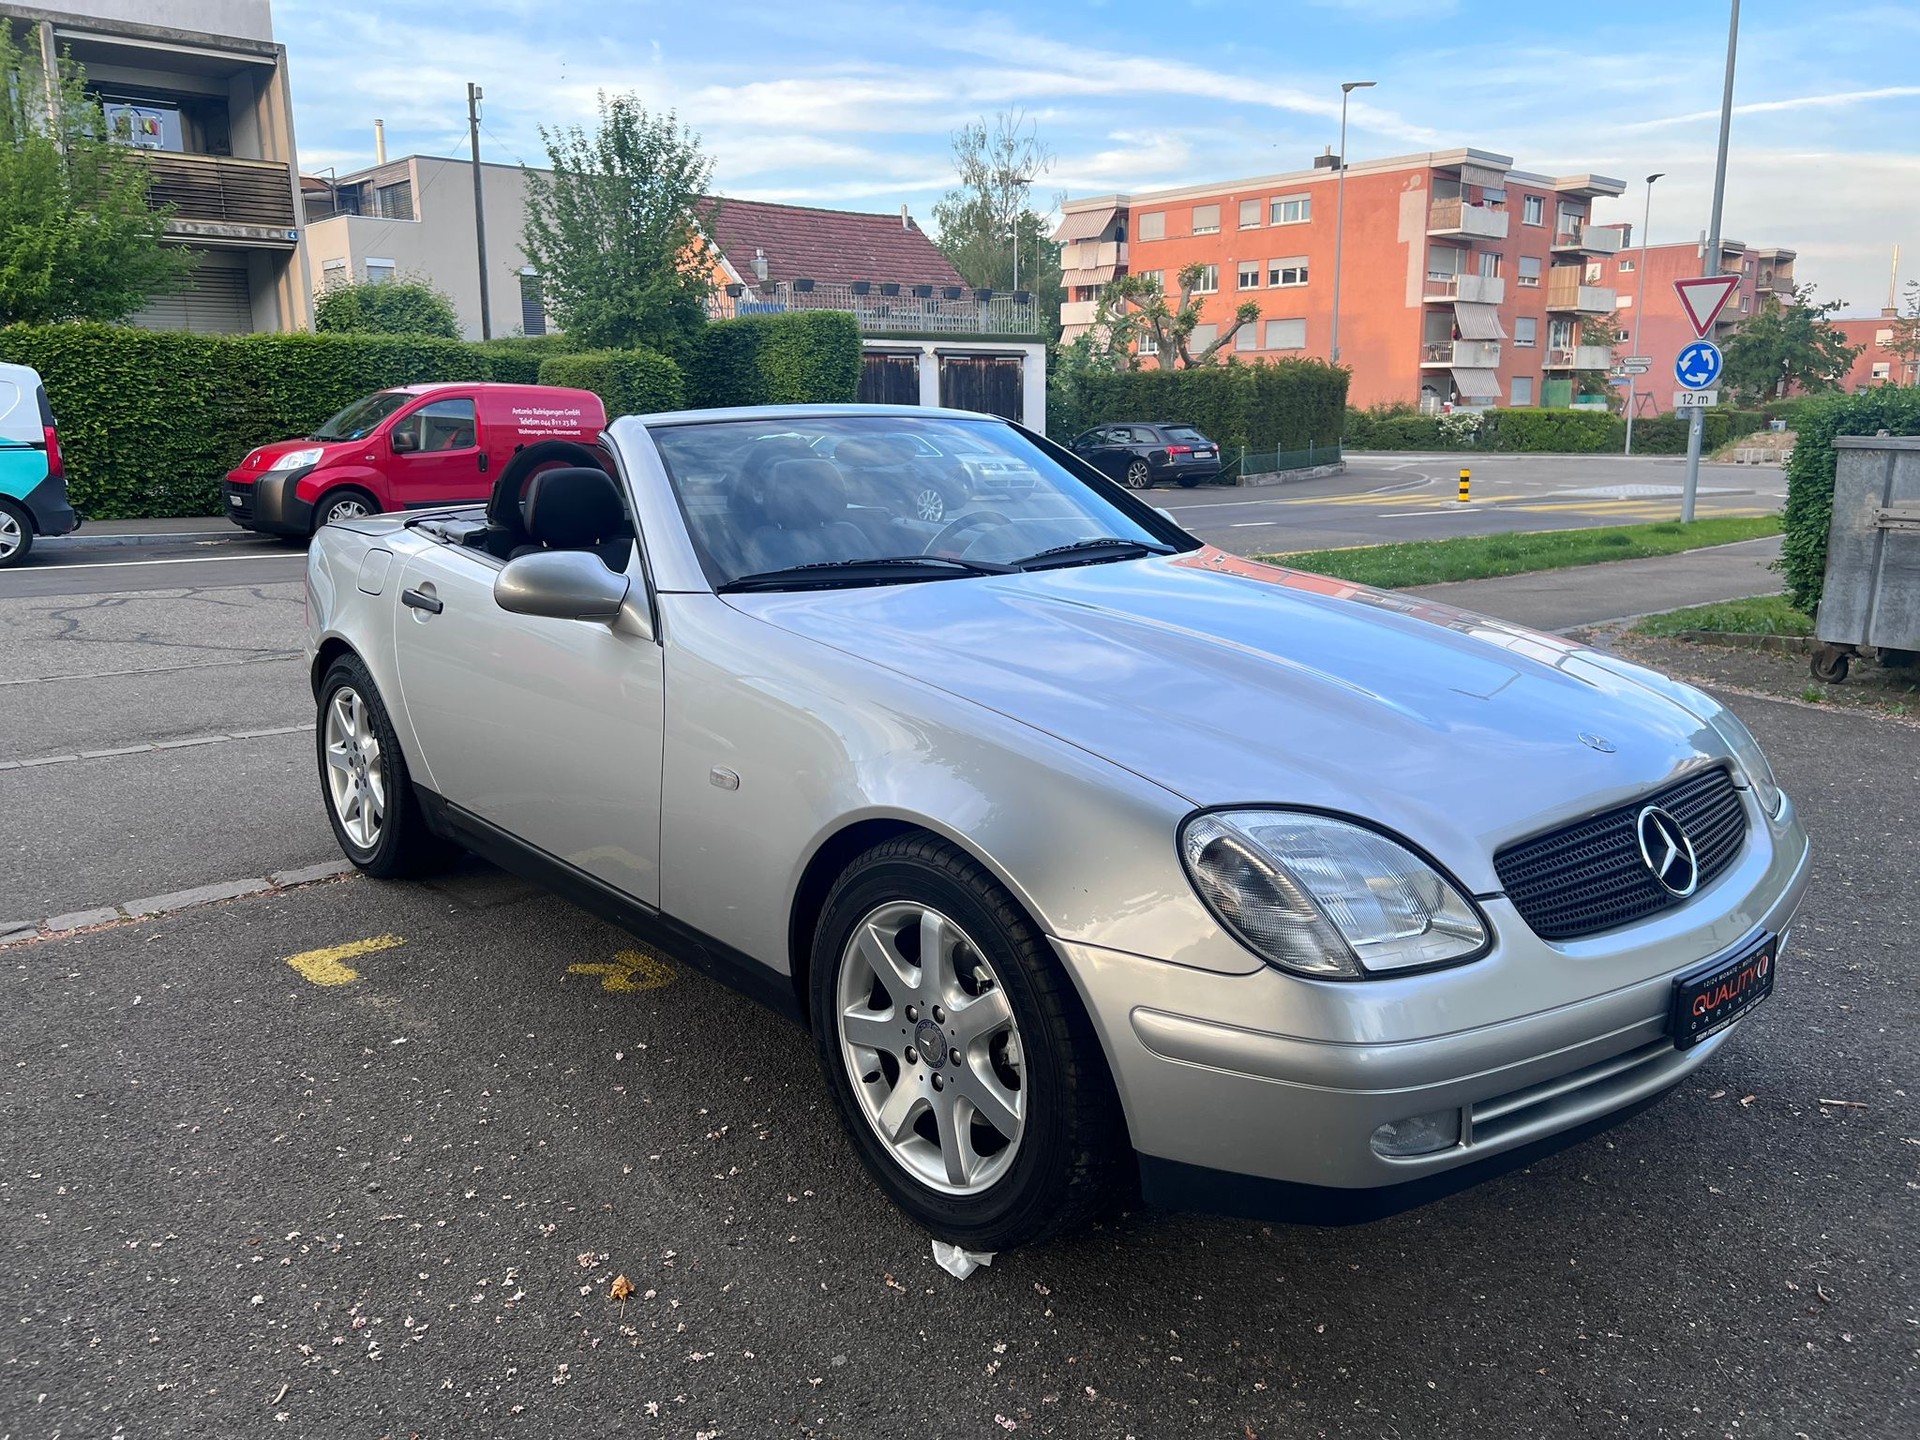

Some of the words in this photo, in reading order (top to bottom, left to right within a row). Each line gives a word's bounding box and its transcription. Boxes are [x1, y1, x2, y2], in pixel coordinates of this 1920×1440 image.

[1682, 393, 1693, 405] 12
[1697, 395, 1709, 405] m
[519, 418, 539, 426] Telefon
